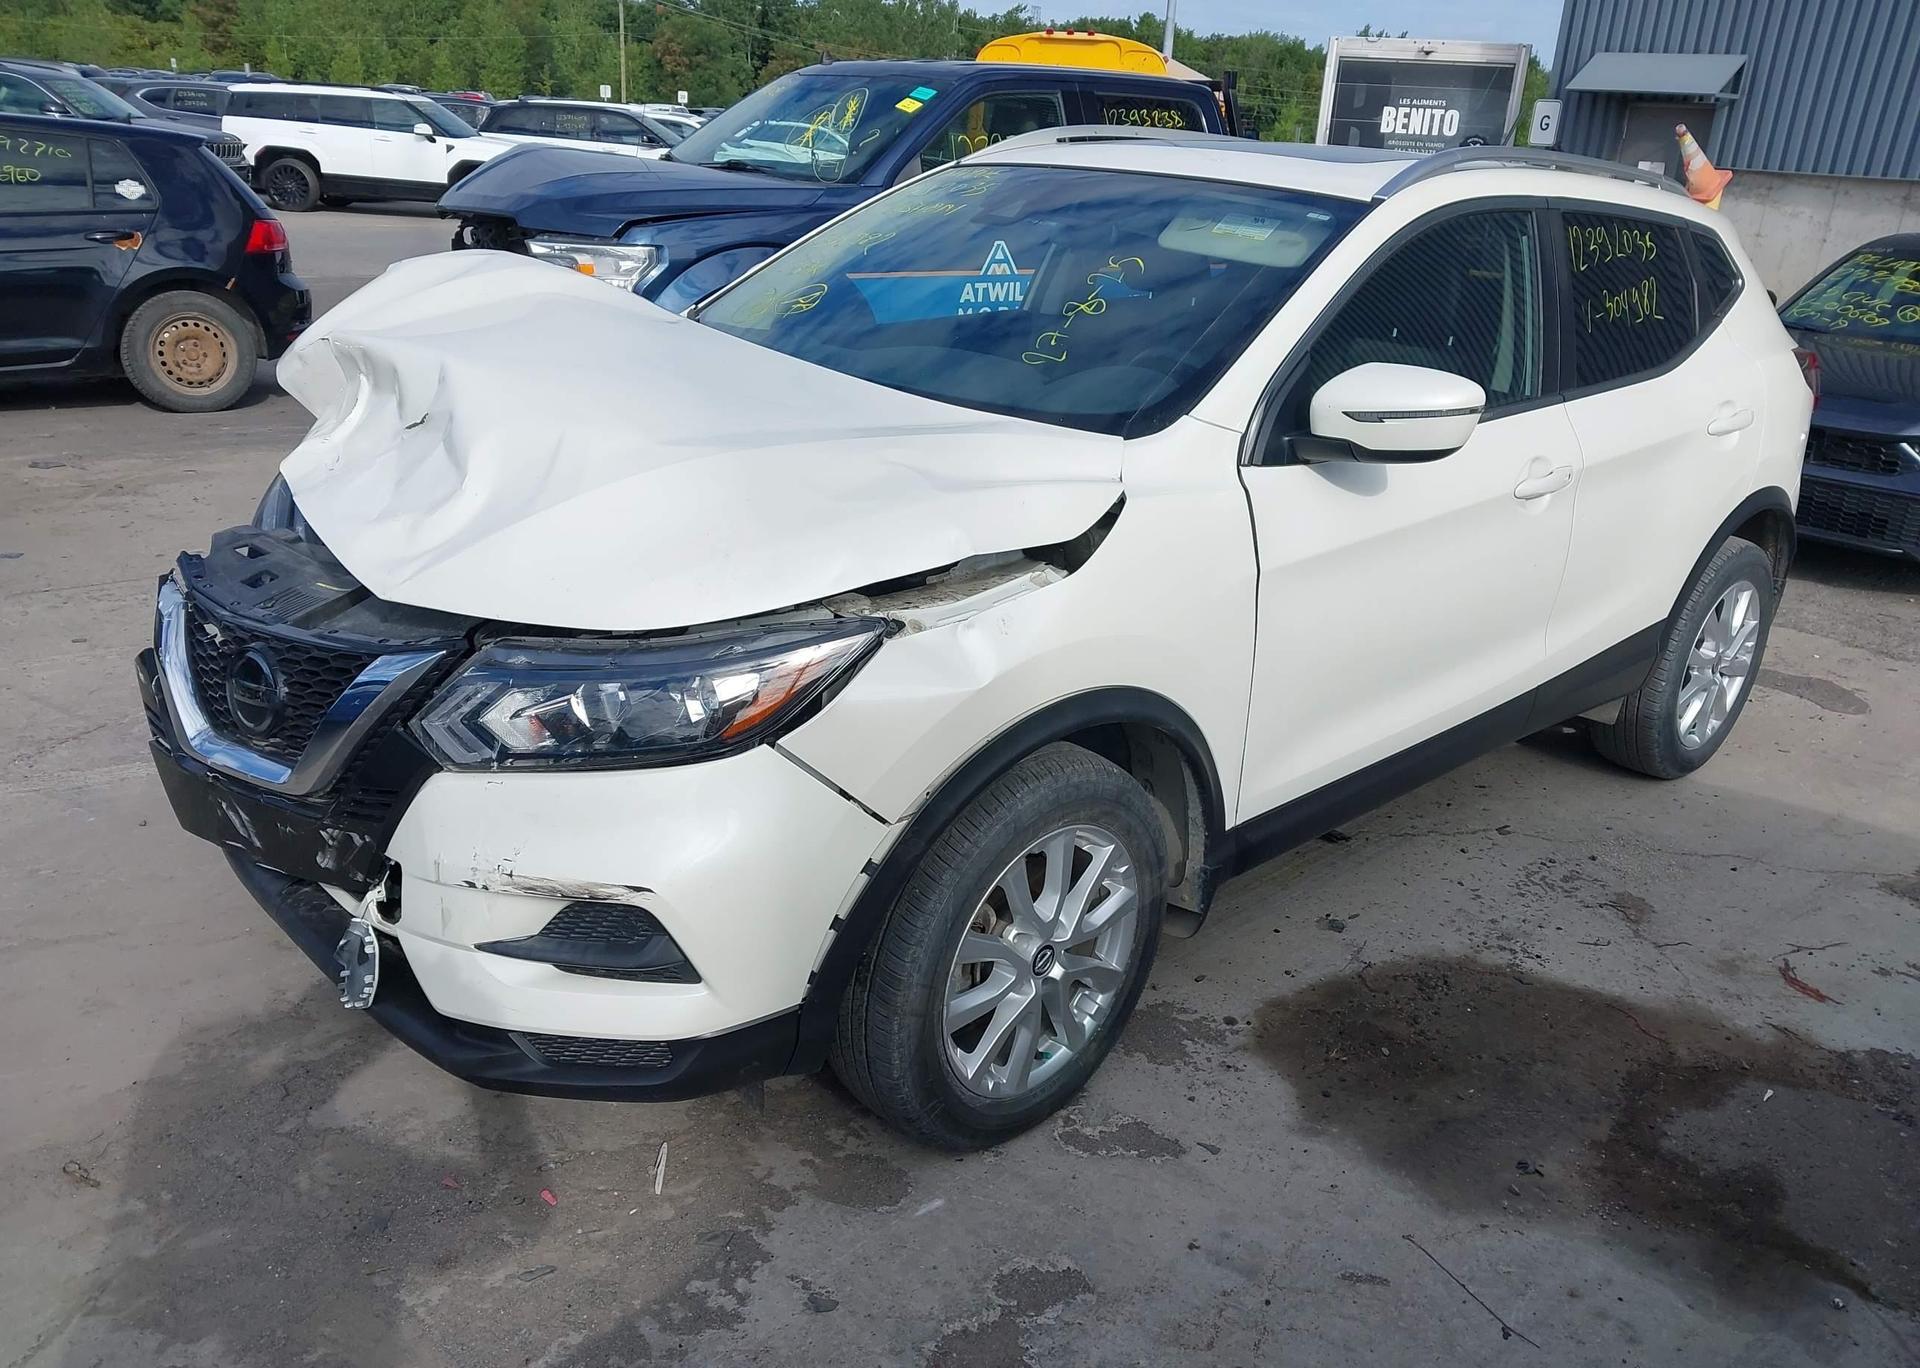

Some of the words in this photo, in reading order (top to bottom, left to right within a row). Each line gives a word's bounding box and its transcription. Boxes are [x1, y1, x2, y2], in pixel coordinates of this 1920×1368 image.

[1412, 99, 1446, 107] ALIMENTS
[1380, 105, 1460, 137] BENITO
[1540, 115, 1551, 131] G
[959, 280, 1030, 303] ATWIL
